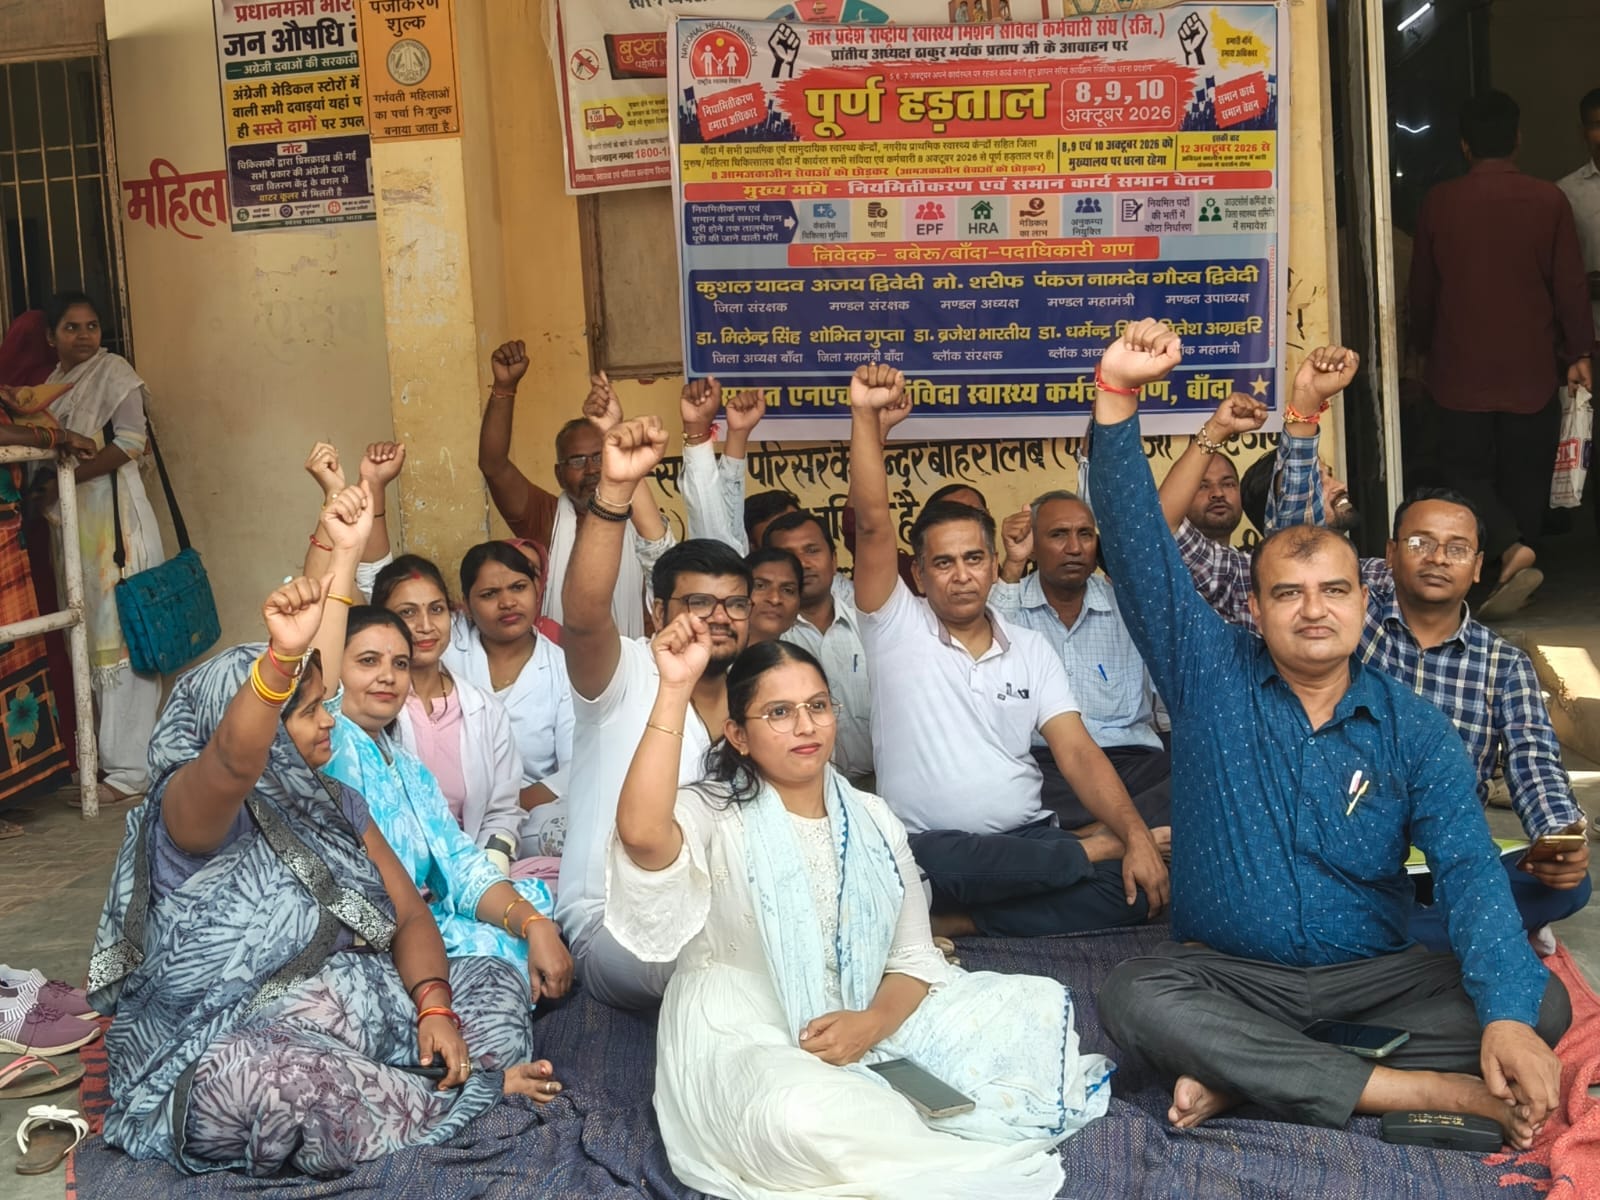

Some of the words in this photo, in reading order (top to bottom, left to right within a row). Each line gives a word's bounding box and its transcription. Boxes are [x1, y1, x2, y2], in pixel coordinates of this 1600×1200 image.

[223, 30, 266, 56] जन
[272, 17, 345, 53] औषधि
[385, 16, 427, 37] शुल्क
[807, 29, 832, 46] उत्तर
[834, 25, 866, 45] प्रदेश
[912, 26, 954, 44] स्वास्थ्य
[1043, 16, 1093, 38] कर्मचारी
[681, 26, 704, 59] NATIONAL
[737, 27, 758, 58] MISSION
[831, 47, 867, 62] प्रांतीय
[872, 47, 911, 60] अध्यक्ष
[915, 46, 947, 61] ठाकुर
[949, 43, 982, 57] मयंक
[987, 43, 1019, 58] प्रताप
[1022, 40, 1039, 55] जी
[1043, 40, 1056, 54] के
[1060, 40, 1108, 54] आवाहन
[1112, 40, 1128, 52] पर
[275, 57, 302, 72] दवाओं
[306, 55, 318, 69] की
[321, 52, 358, 68] सरकारी
[233, 83, 267, 101] अंग्रेजी
[271, 81, 314, 96] मेडिकल
[317, 76, 347, 92] स्टोरों
[350, 75, 360, 90] में
[373, 89, 405, 103] गर्भवती
[410, 86, 450, 101] महिलाओं
[232, 103, 258, 118] वाली
[261, 100, 283, 115] सभी
[287, 97, 325, 113] दवाइयां
[329, 94, 349, 109] यहां
[391, 106, 409, 119] पर्चा
[803, 75, 886, 137] पूर्ण
[896, 81, 1051, 133] हड़ताल
[237, 123, 249, 138] ही
[253, 118, 283, 135] सस्ते
[287, 115, 317, 134] दामों
[321, 118, 336, 131] पर
[442, 119, 449, 132] है
[1066, 107, 1123, 130] अक्टूबर
[1129, 106, 1172, 121] 2026
[788, 142, 828, 155] सामुदायिक
[1079, 138, 1092, 151] एवं
[1095, 141, 1104, 151] 10
[1106, 139, 1138, 153] अक्टूबर
[1140, 139, 1159, 150] 2026
[1162, 136, 1173, 148] को
[1181, 144, 1190, 153] 12
[1193, 143, 1232, 156] अक्टूबर
[1234, 143, 1257, 152] 2026
[1261, 141, 1271, 152] से
[989, 150, 1001, 163] पूर्ण
[1069, 156, 1108, 171] मुख्यालय
[1110, 156, 1121, 166] पर
[1123, 155, 1144, 165] धरना
[1147, 153, 1166, 165] रहेगा
[743, 184, 786, 200] मुख्य
[848, 179, 974, 196] नियमितीकरण
[979, 177, 1005, 192] एवं
[1012, 177, 1064, 191] समान
[1071, 174, 1112, 190] कार्य
[1117, 175, 1168, 188] समान
[1174, 172, 1215, 186] वेतन
[916, 223, 944, 236] EPF
[969, 222, 999, 234] HRA
[1102, 241, 1136, 256] गण
[696, 279, 751, 300] कुशल
[755, 278, 805, 293] यादव
[811, 276, 865, 292] अजय
[869, 272, 924, 293] द्विवेदी
[932, 272, 964, 290] मो.
[969, 270, 1024, 289] शरीफ
[1033, 269, 1084, 287] पंकज
[1087, 268, 1149, 286] नामदेव
[1205, 264, 1260, 285] द्विवेदी
[713, 300, 744, 313] जिला
[747, 299, 788, 312] संरक्षक
[829, 299, 864, 311] मण्डल
[868, 298, 910, 311] संरक्षक
[940, 298, 977, 310] मण्डल
[980, 297, 1020, 309] अध्यक्ष
[1047, 296, 1084, 308] मण्डल
[1088, 293, 1135, 307] महामंत्री
[1165, 294, 1201, 305] मण्डल
[1204, 293, 1250, 304] उपाध्यक्ष
[696, 329, 717, 345] डा.
[721, 325, 769, 346] मिलेन्द्र
[772, 325, 802, 345] सिंह
[810, 324, 862, 345] शोभित
[865, 328, 905, 348] गुप्ता
[914, 327, 935, 343] डा.
[938, 323, 978, 342] ब्रजेश
[979, 320, 1031, 341] भारतीय
[1038, 325, 1061, 340] डा.
[1065, 319, 1112, 340] धर्मेन्द्र
[1204, 316, 1264, 336] अग्रहरि
[712, 352, 740, 365] जिला
[743, 352, 777, 365] अध्यक्ष
[781, 349, 804, 364] बाँदा
[817, 350, 841, 363] जिला
[844, 348, 881, 362] महामंत्री
[884, 348, 905, 362] बाँदा
[932, 347, 962, 361] ब्लॉक
[965, 346, 1003, 361] संरक्षक
[1048, 346, 1077, 360] ब्लॉक
[1199, 341, 1241, 356] महामंत्री
[966, 383, 1040, 404] स्वास्थ्य
[1186, 374, 1234, 401] बाँदा
